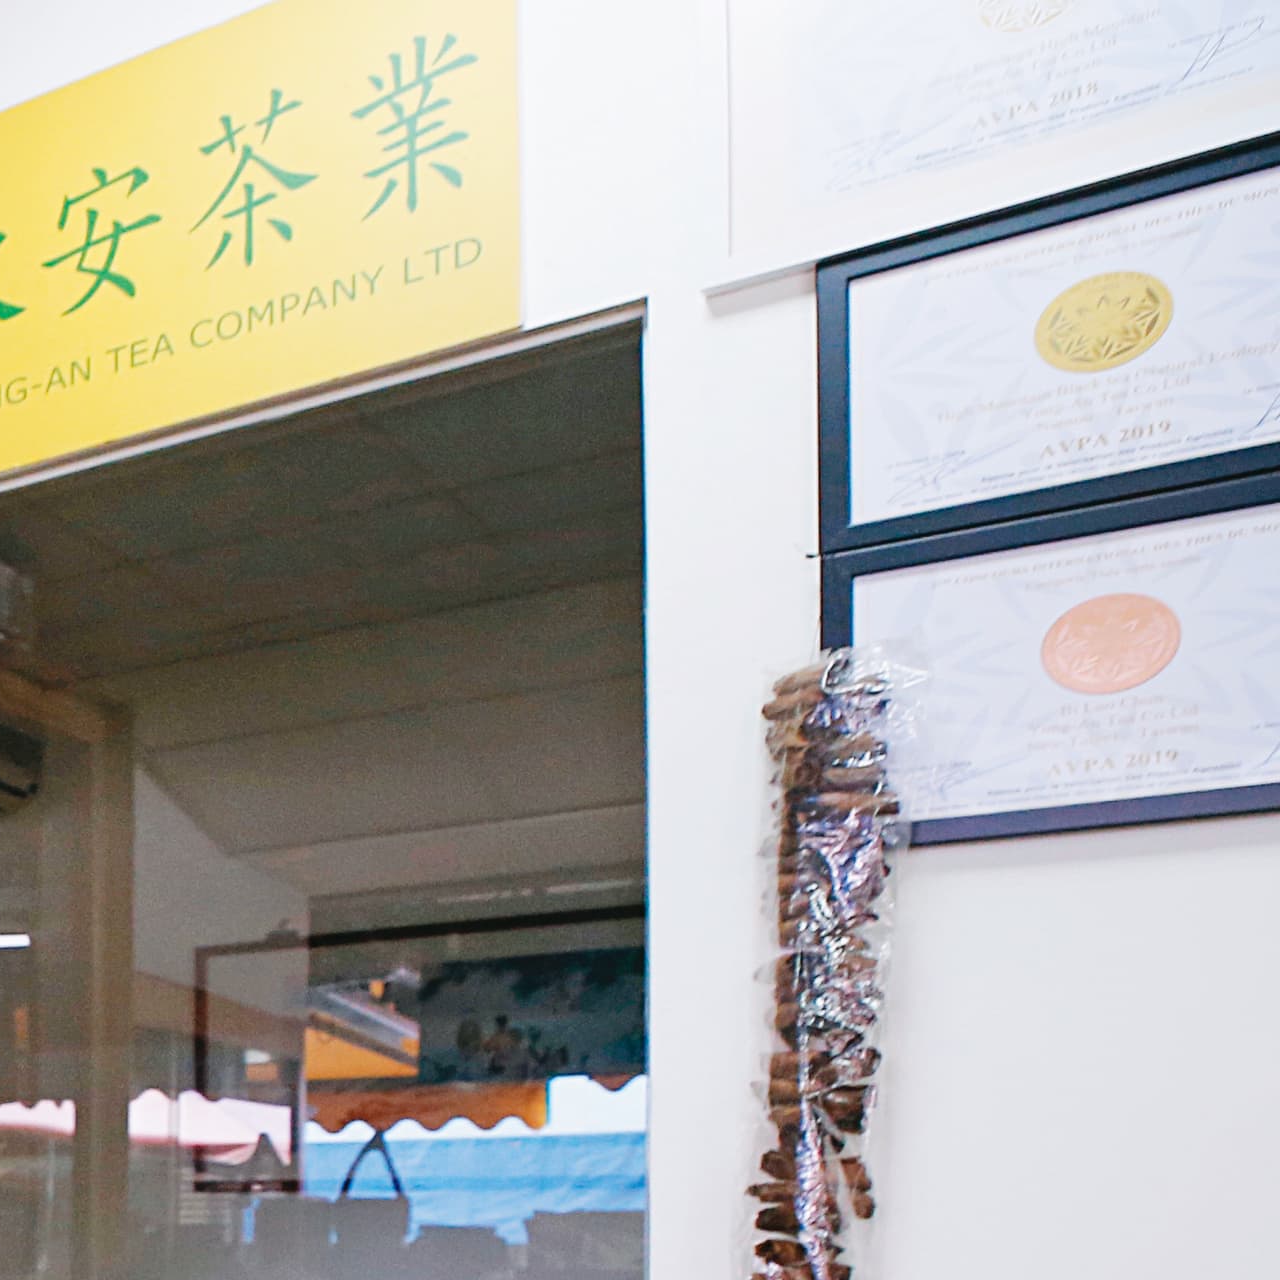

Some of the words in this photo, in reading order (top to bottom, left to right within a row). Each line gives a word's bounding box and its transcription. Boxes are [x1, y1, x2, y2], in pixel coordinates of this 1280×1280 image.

[1050, 82, 1099, 107] 2018
[106, 333, 175, 373] TEA
[189, 263, 385, 348] COMPANY
[403, 237, 483, 285] LTD
[1041, 434, 1109, 459] AVPA
[1120, 420, 1172, 443] 2019
[1050, 757, 1115, 777] AVPA
[1126, 749, 1179, 769] 2019
